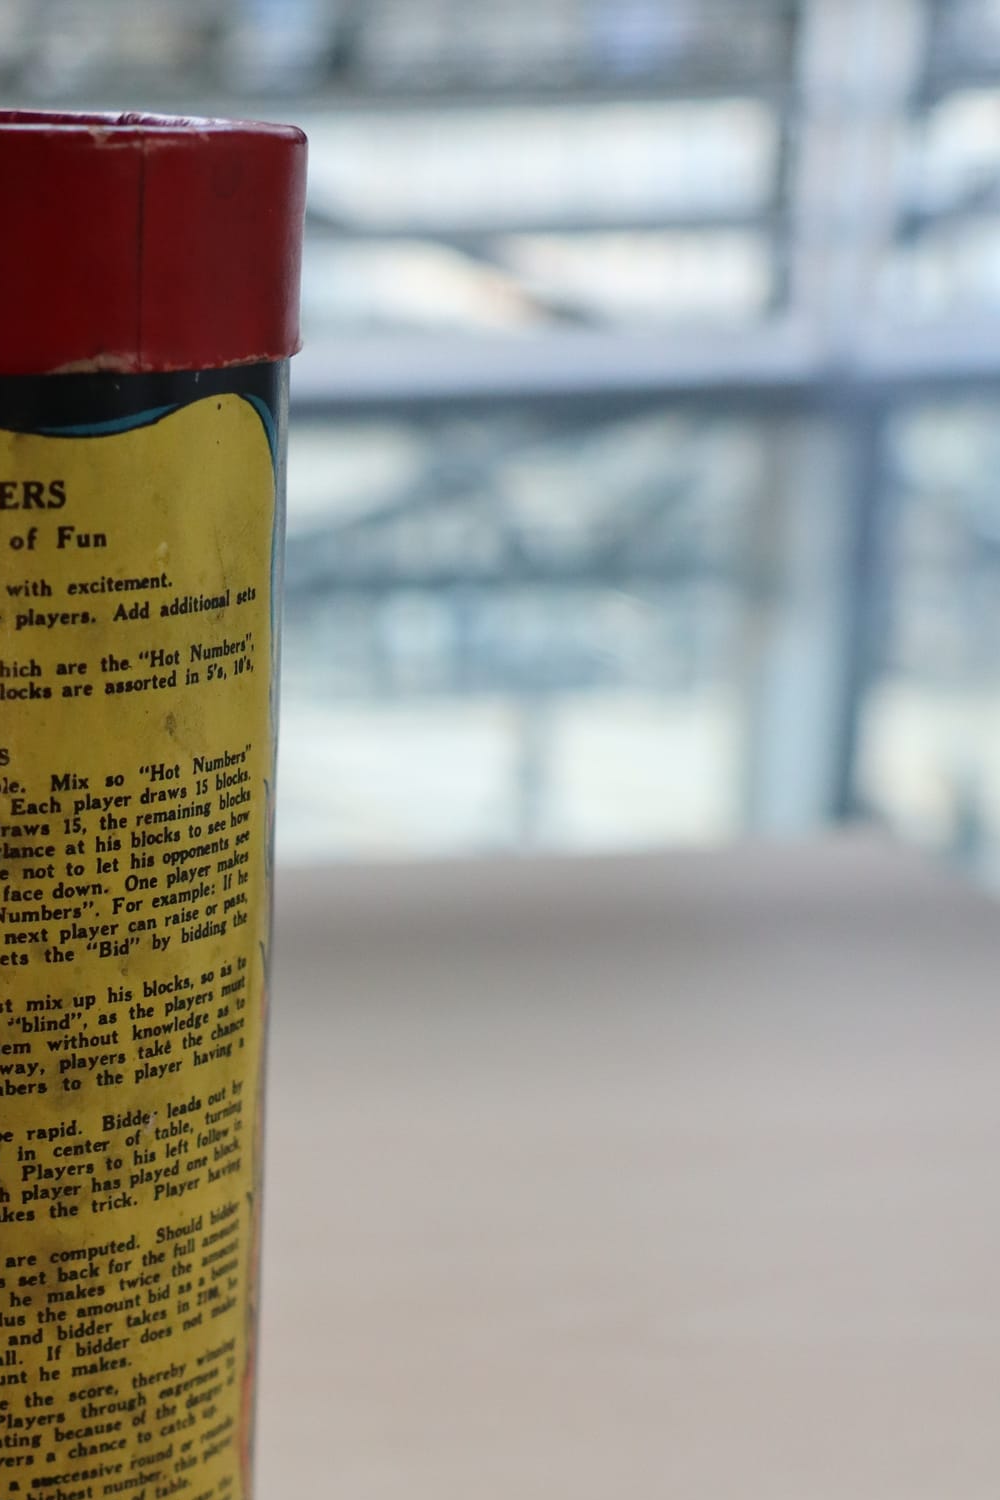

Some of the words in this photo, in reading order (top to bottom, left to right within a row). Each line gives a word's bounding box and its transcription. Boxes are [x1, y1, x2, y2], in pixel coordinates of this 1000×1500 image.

[9, 527, 38, 551] of
[56, 526, 107, 549] Fun
[6, 579, 52, 597] with
[67, 572, 172, 596] excitement.
[16, 608, 96, 631] players.
[113, 601, 150, 622] Add
[160, 588, 230, 618] additional
[236, 587, 256, 605] sets
[56, 663, 87, 675] are
[100, 654, 132, 672] the
[62, 684, 93, 698] are
[105, 669, 177, 695] assorted
[185, 668, 199, 685] in
[207, 663, 227, 681] 5's,
[50, 773, 89, 792] Mix
[105, 774, 125, 788] so
[4, 928, 48, 945] next
[60, 923, 119, 943] player
[128, 918, 157, 933] can
[164, 907, 199, 927] raise
[205, 903, 218, 917] or
[39, 1366, 60, 1382] he
[71, 1355, 132, 1377] makes.
